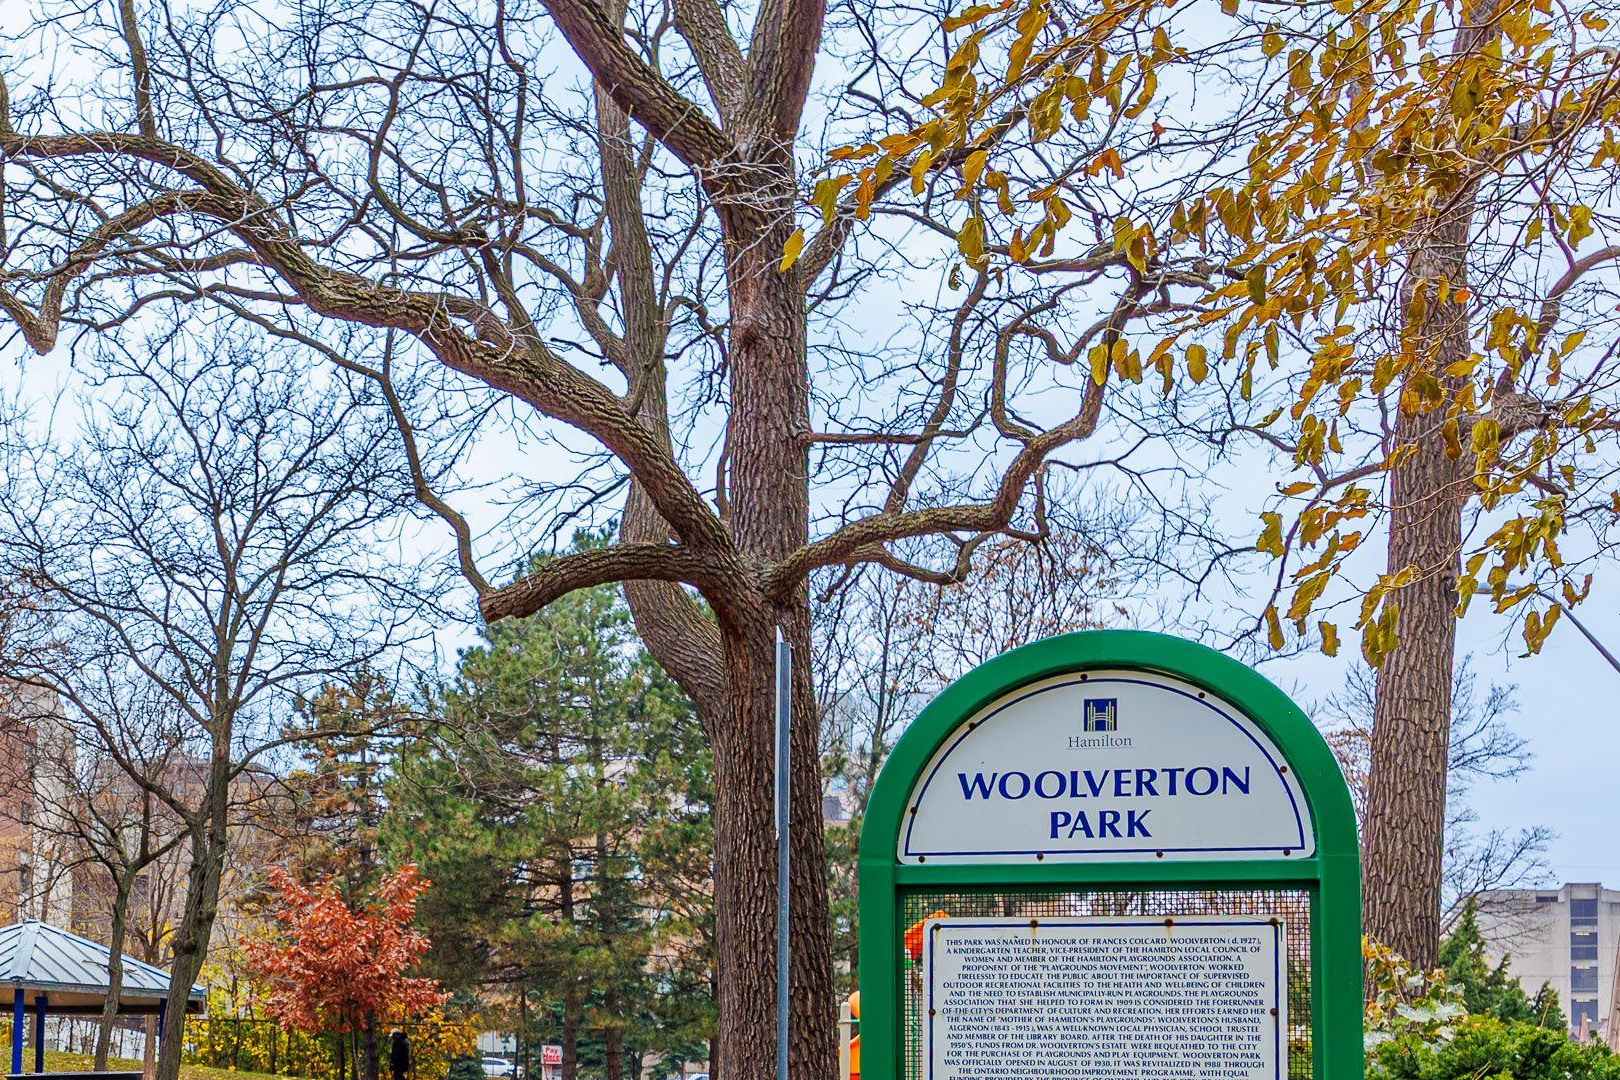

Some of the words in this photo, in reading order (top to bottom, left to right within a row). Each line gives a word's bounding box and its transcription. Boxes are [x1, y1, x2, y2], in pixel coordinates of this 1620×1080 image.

[1069, 735, 1132, 748] Hamilton
[957, 766, 1250, 800] WOOLVERTON
[1050, 809, 1152, 839] PARK
[1154, 1043, 1205, 1051] BEQUEATHED
[1133, 1052, 1179, 1060] EQUIPMENT.
[1010, 1068, 1081, 1076] NEIGHBOURHOOD
[1223, 1070, 1249, 1078] EQUAL
